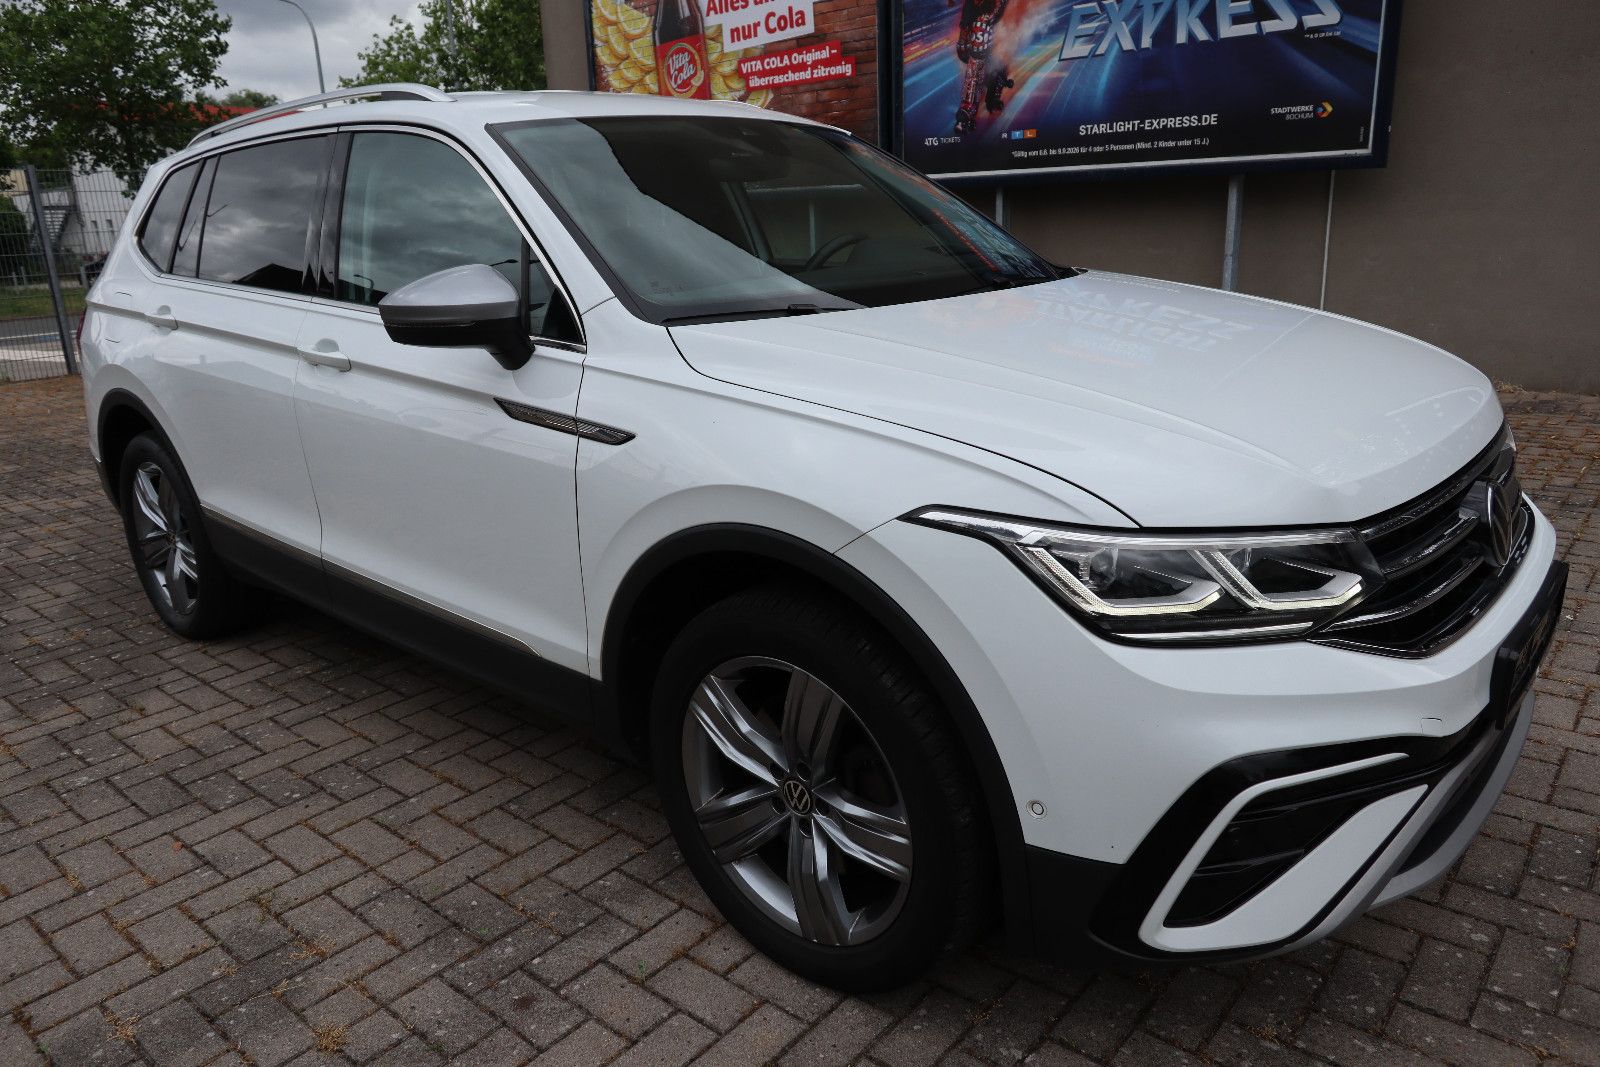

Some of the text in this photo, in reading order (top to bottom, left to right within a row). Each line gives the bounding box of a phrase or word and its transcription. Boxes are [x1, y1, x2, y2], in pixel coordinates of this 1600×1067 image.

[706, 0, 749, 17] Alles
[730, 6, 806, 43] nur Cola
[668, 51, 690, 74] Vita
[741, 60, 762, 74] VITA
[764, 55, 790, 69] COLA
[791, 46, 830, 65] Original
[670, 62, 695, 89] Cola
[749, 62, 852, 87] überraschend zitronig
[1270, 104, 1314, 115] STADTWERKE
[1285, 112, 1314, 120] BOCHUM
[1001, 130, 1034, 139] RTL
[1079, 113, 1218, 136] STARLIGHT-EXPRESS.DE
[940, 136, 961, 144] TICKETS
[1110, 143, 1134, 151] Personen
